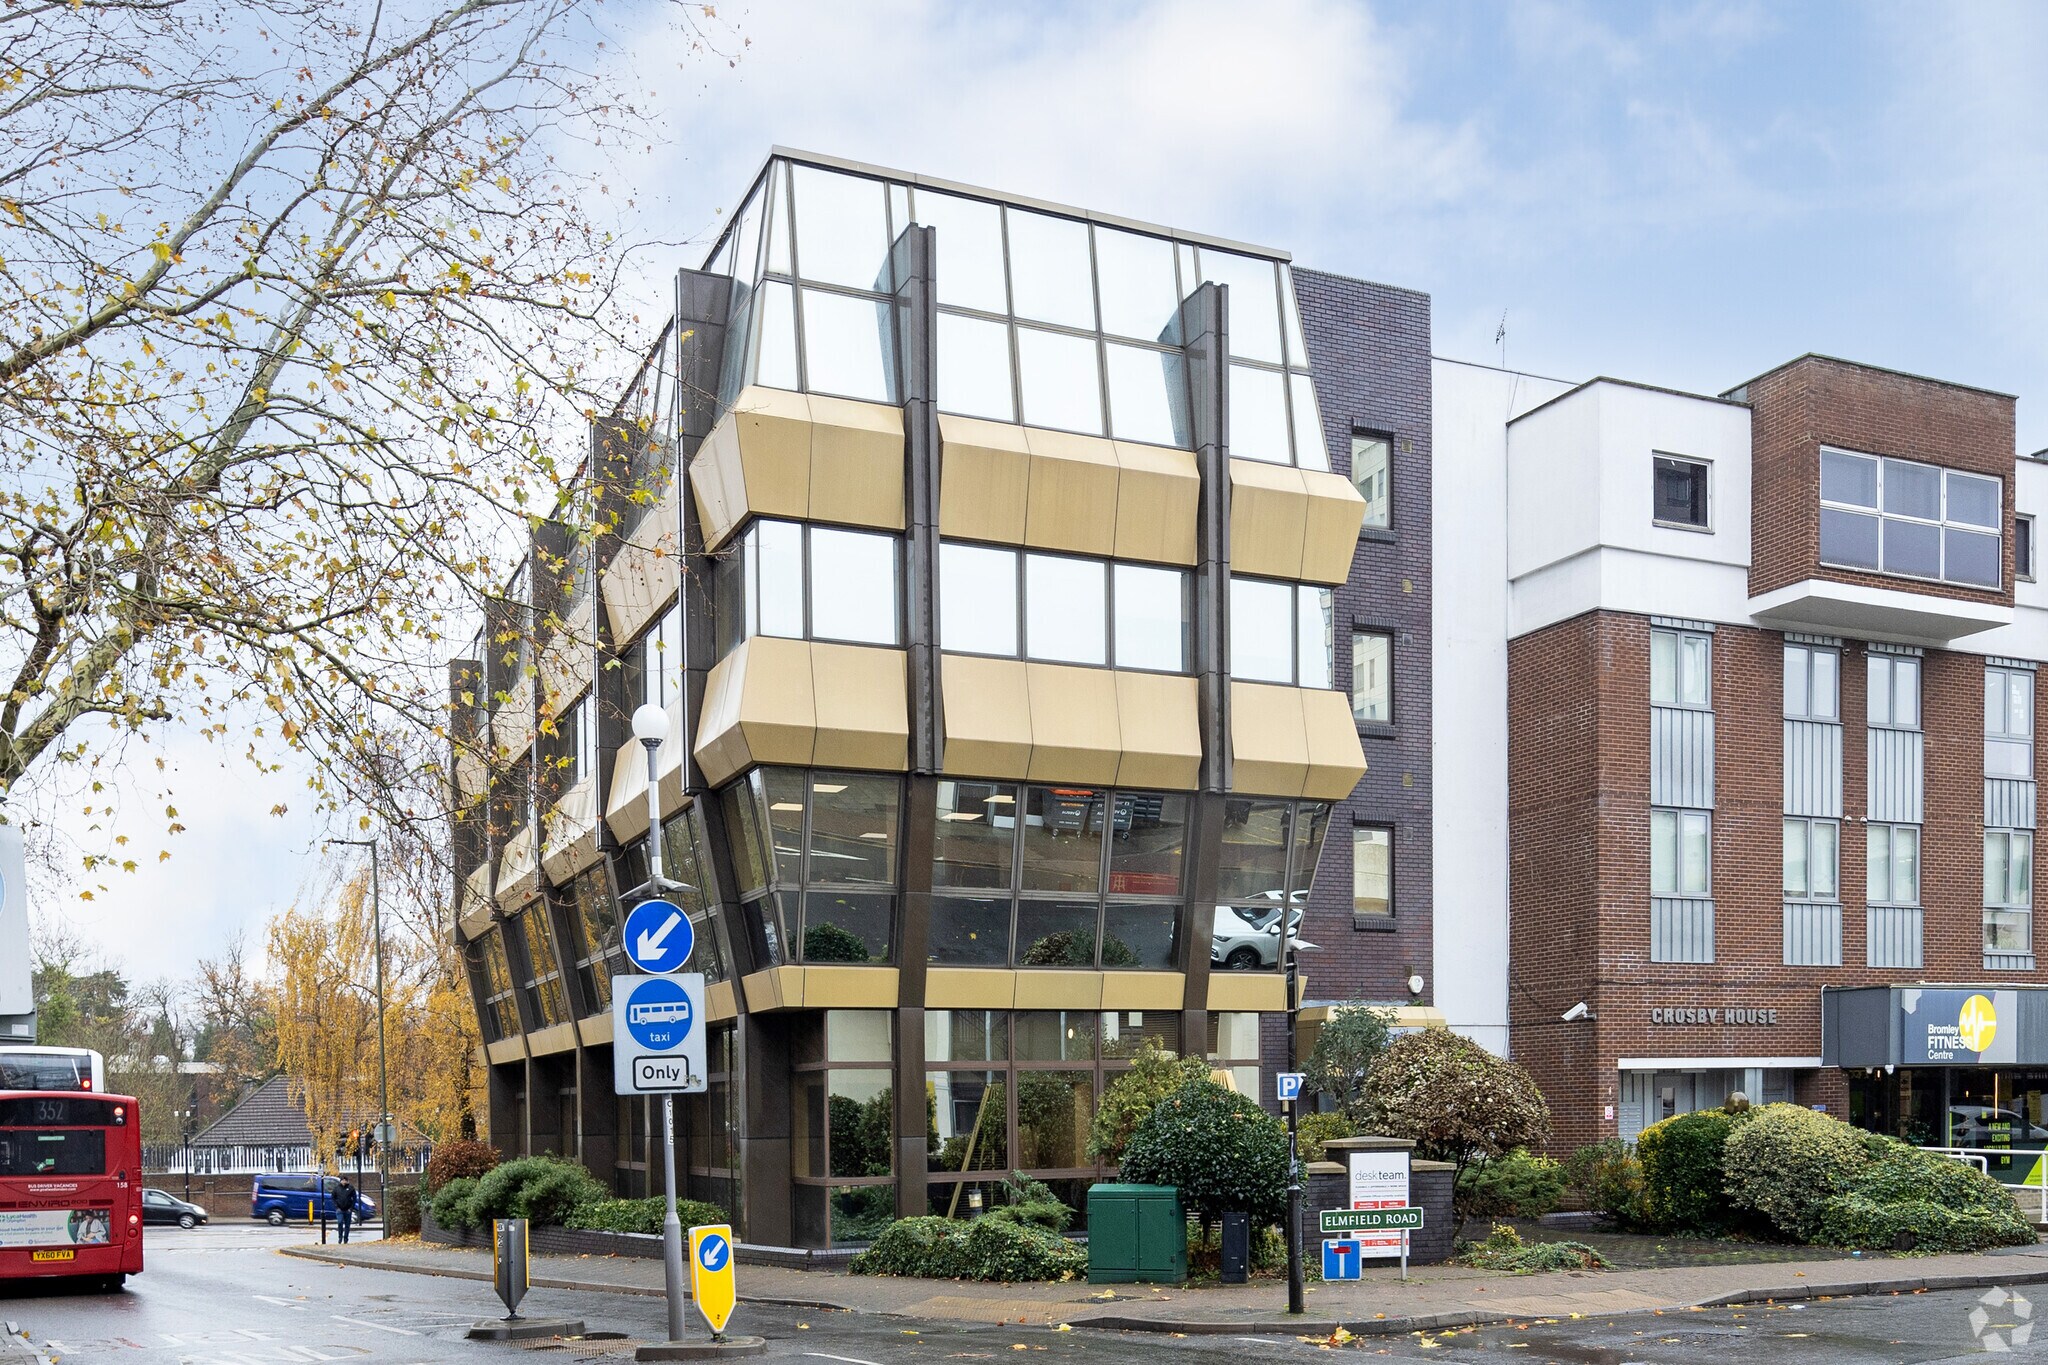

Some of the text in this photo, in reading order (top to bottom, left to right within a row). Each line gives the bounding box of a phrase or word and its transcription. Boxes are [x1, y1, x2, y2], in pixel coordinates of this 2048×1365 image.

[1652, 1008, 1777, 1024] CROSBY HOUSE
[1927, 1023, 1960, 1036] Bromley
[650, 1032, 670, 1042] taxi
[1927, 1036, 1973, 1049] FITNESS
[1927, 1049, 1954, 1060] Centre
[642, 1065, 680, 1081] Only
[1282, 1077, 1296, 1096] P
[39, 1101, 64, 1120] 352
[18, 1200, 70, 1208] ENVIRO
[1325, 1213, 1418, 1227] ELMFIELD ROAD
